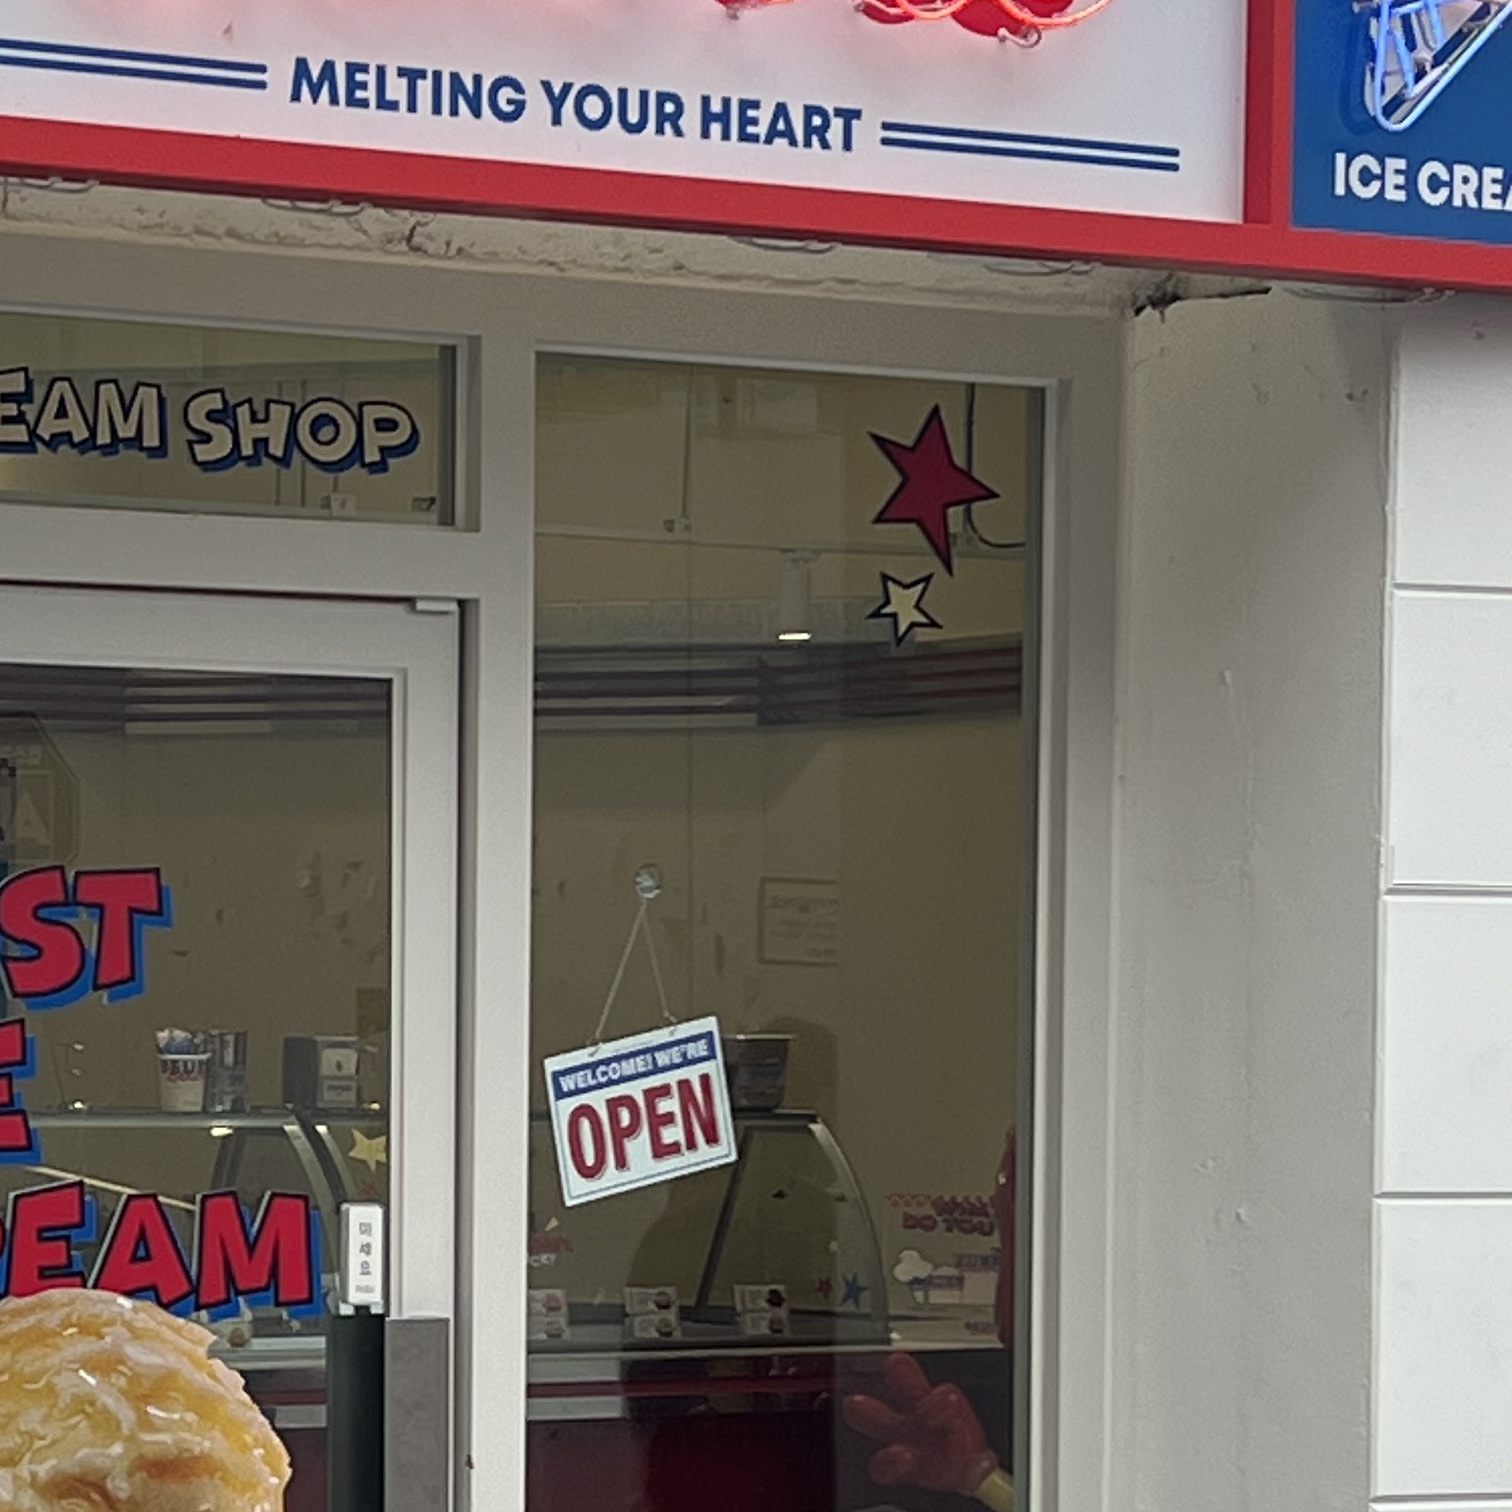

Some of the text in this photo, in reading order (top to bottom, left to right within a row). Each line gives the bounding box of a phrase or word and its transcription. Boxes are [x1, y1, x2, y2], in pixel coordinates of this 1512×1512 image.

[290, 57, 862, 151] MELTING YOUR HEART
[1334, 152, 1512, 212] ICE CRE
[186, 388, 420, 474] SHOP
[560, 1053, 653, 1093] WELCOME!
[567, 1072, 722, 1180] OPEN
